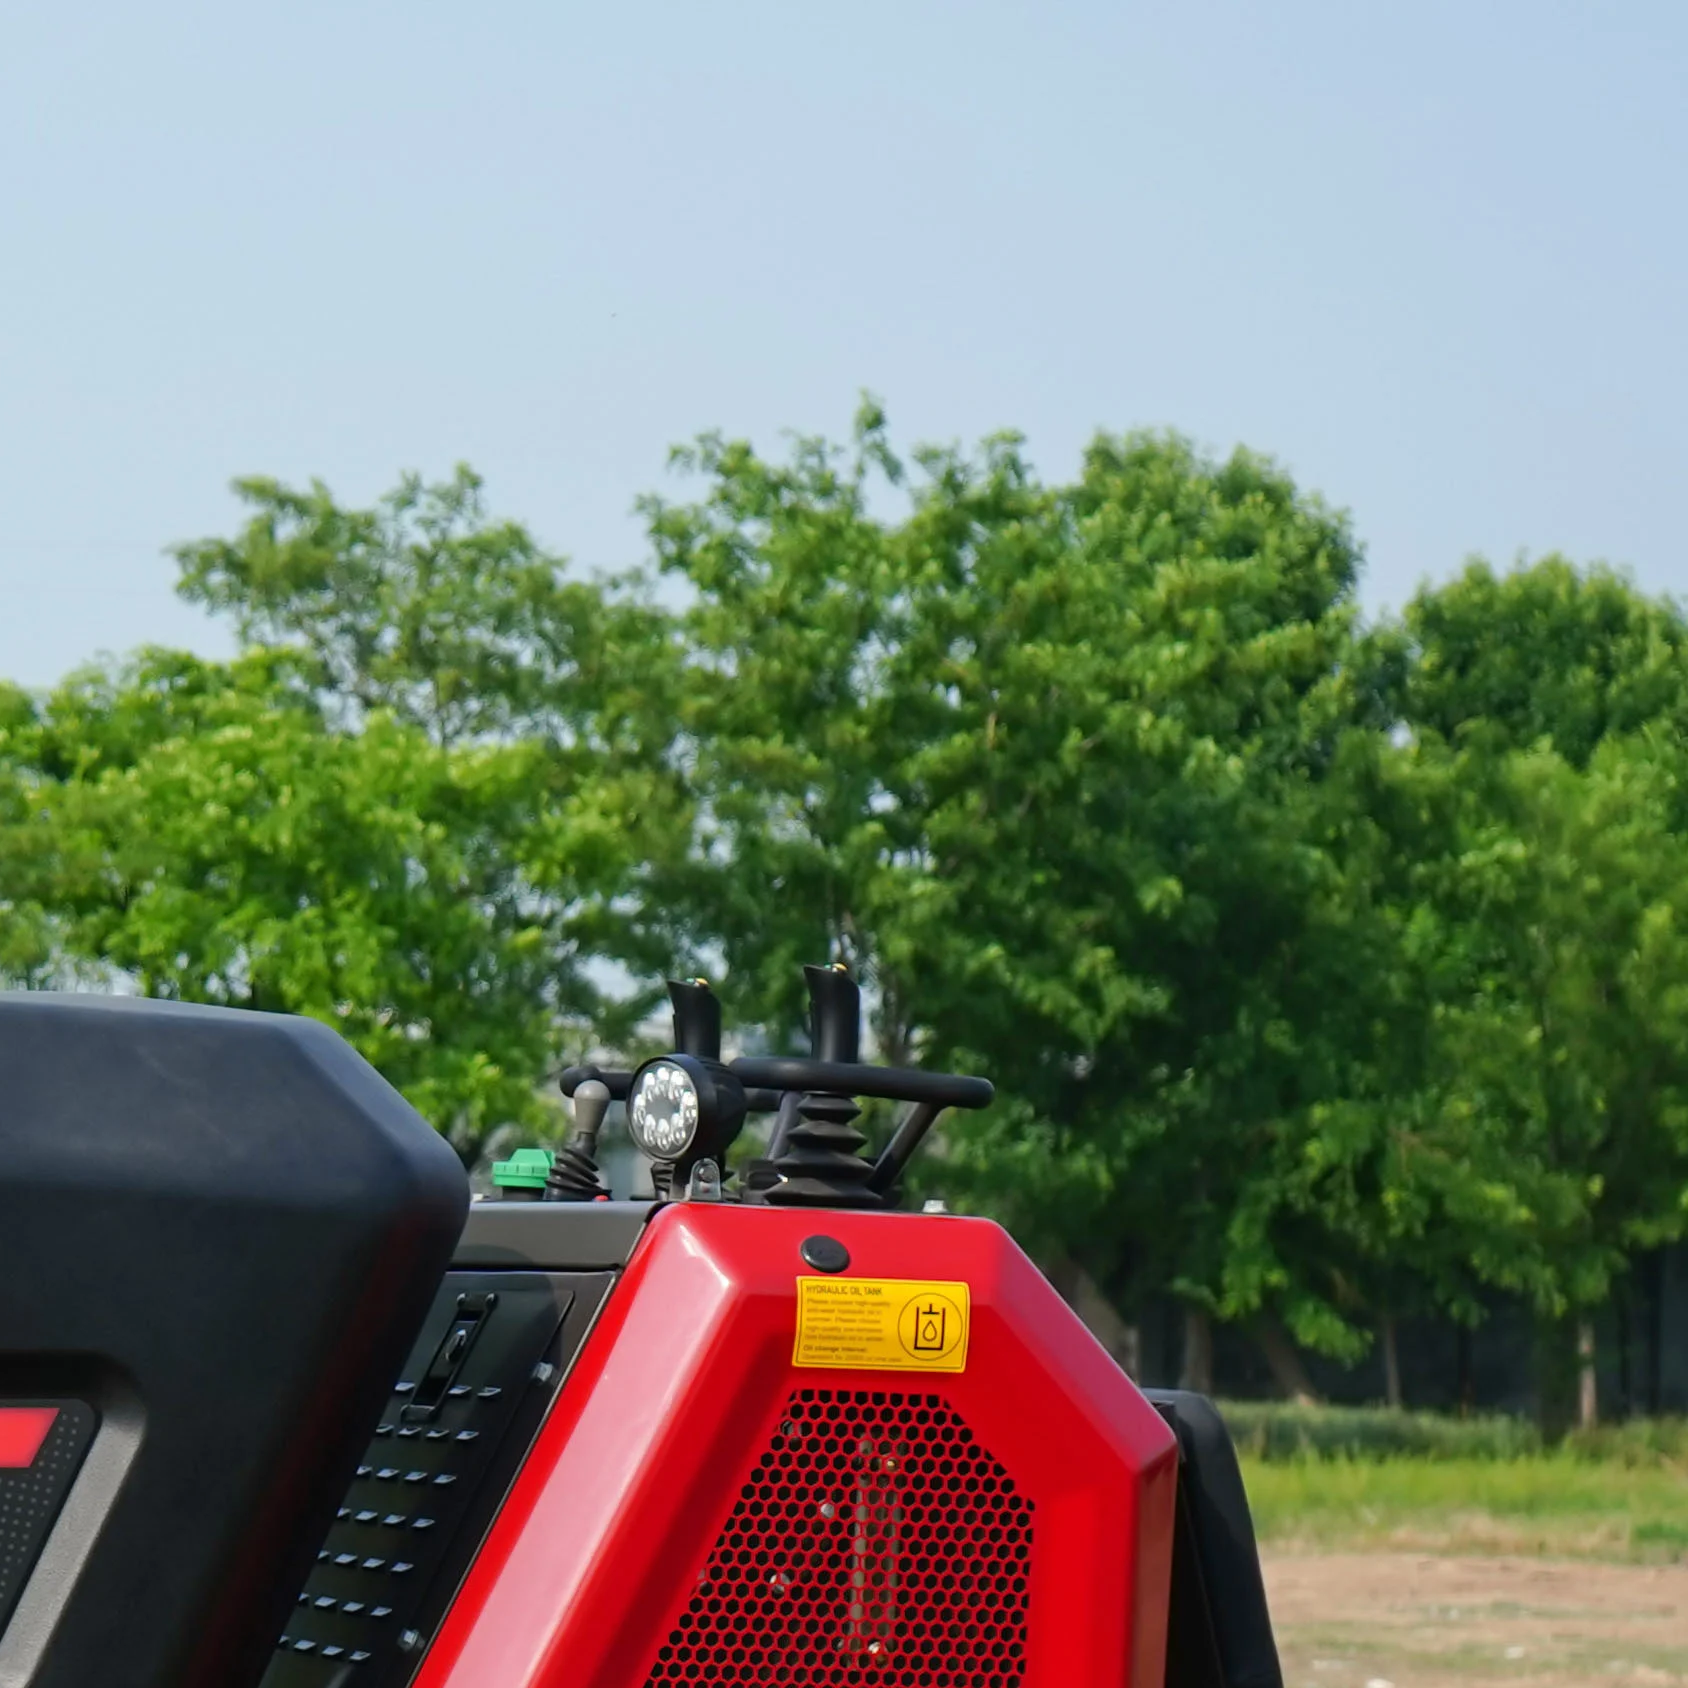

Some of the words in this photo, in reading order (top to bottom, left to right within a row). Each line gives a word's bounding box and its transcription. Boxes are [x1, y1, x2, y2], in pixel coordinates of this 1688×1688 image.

[805, 1284, 848, 1295] HYDRAULIC
[849, 1286, 863, 1296] OIL
[863, 1286, 883, 1297] TANK
